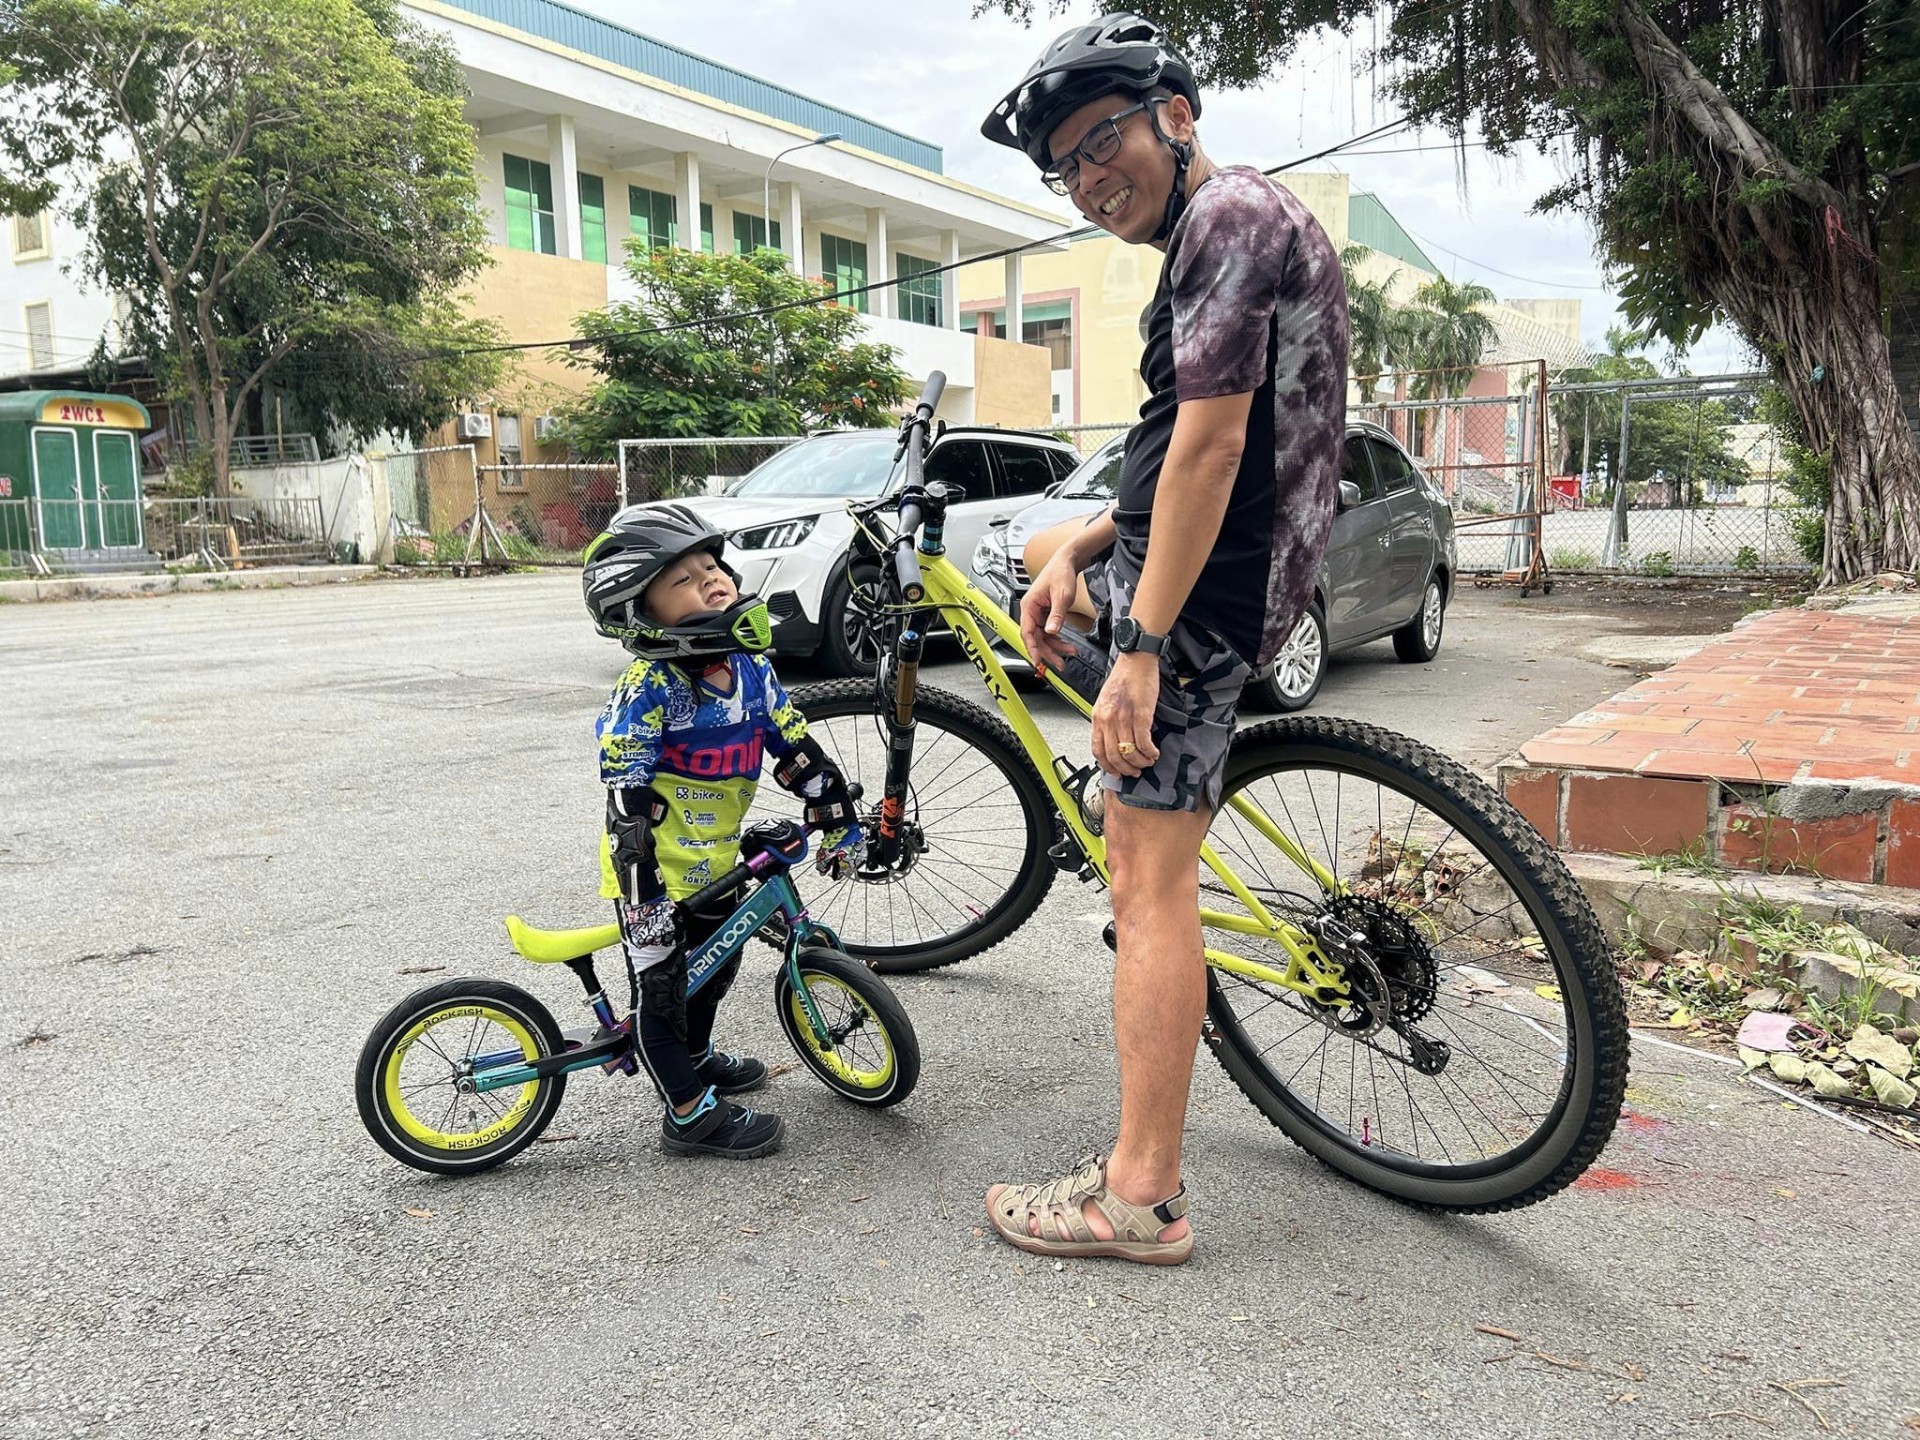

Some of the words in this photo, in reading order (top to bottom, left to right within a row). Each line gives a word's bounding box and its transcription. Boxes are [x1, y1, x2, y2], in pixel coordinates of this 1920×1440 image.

[72, 405, 94, 422] WC
[955, 624, 1008, 701] SURLY
[423, 1008, 484, 1028] ROCKFISH
[448, 1126, 506, 1149] ROCKFISH
